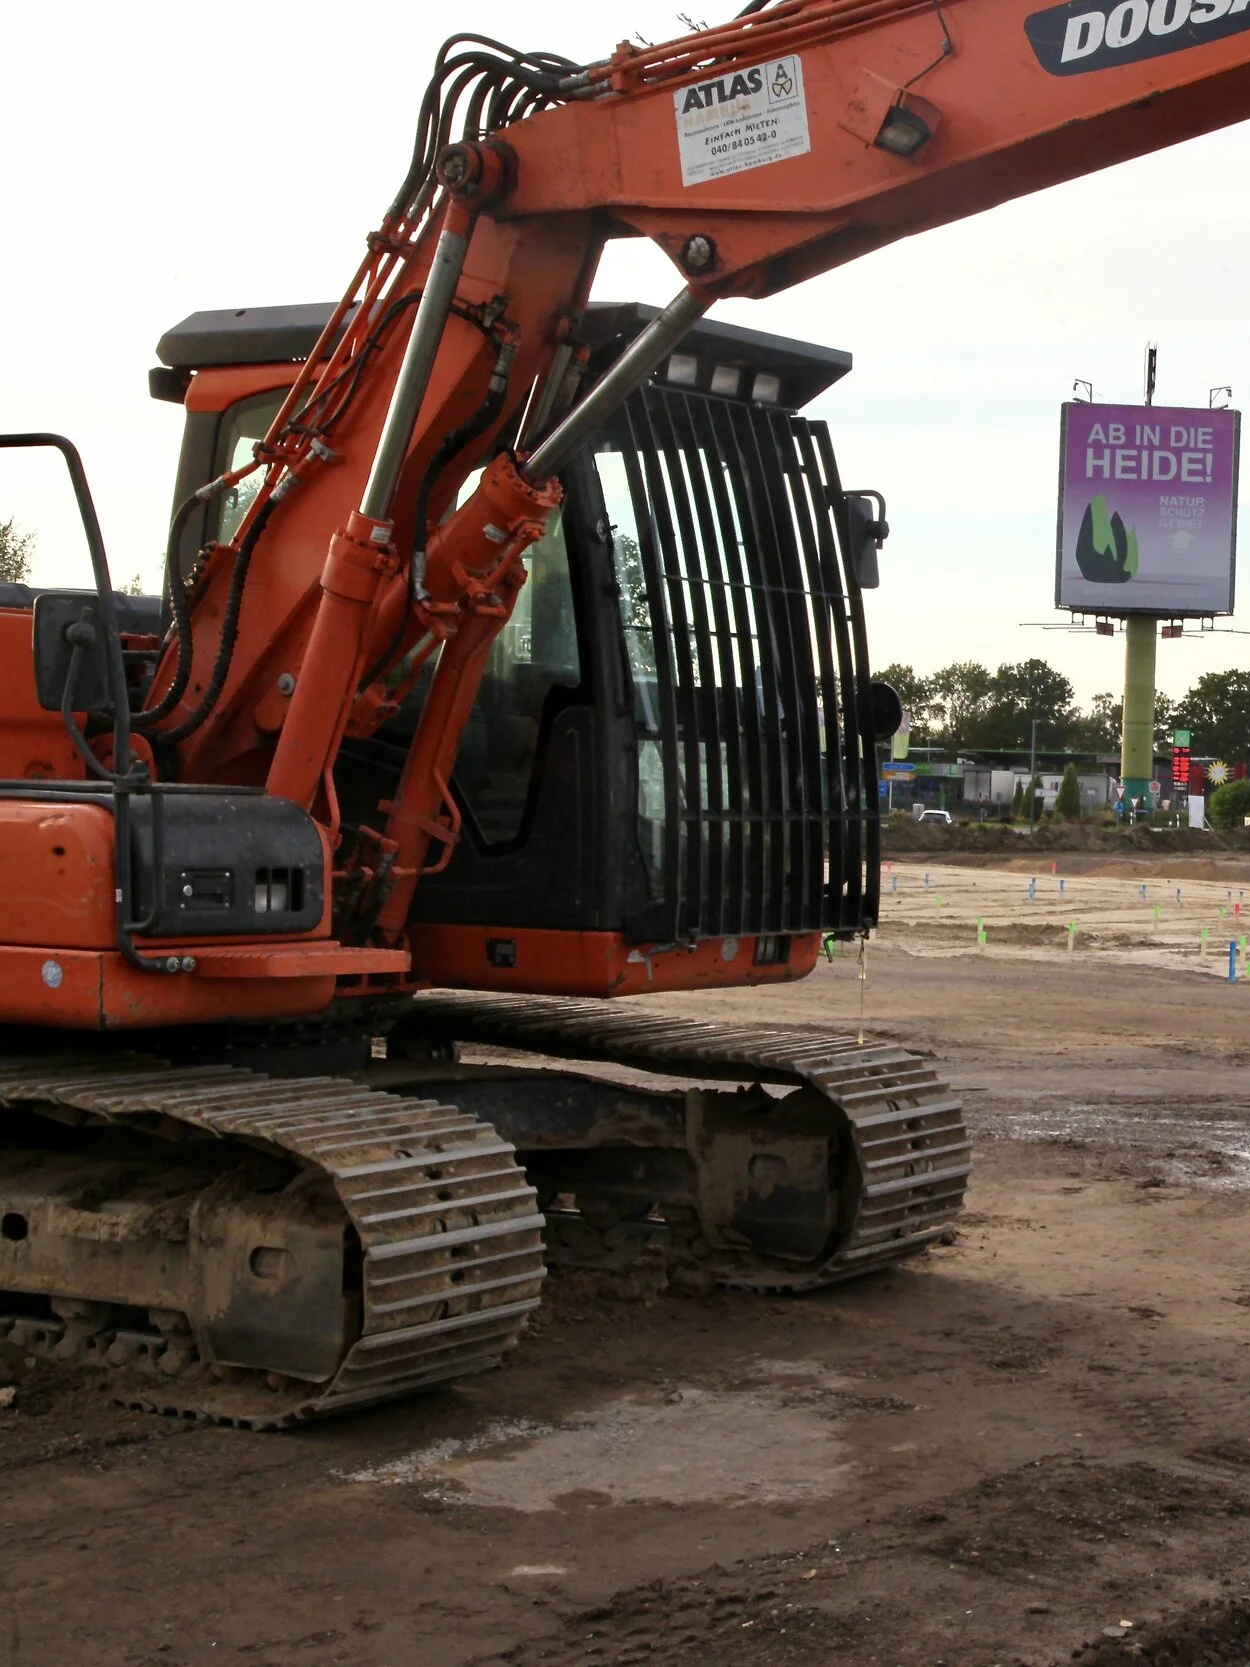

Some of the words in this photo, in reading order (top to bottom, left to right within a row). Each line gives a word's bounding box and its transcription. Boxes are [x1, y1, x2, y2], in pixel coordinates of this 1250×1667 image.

[682, 68, 763, 114] ATLAS
[704, 128, 741, 145] EINFACH
[1087, 423, 1126, 445] AB
[1136, 425, 1160, 447] IN
[1170, 427, 1213, 448] DIE
[1086, 449, 1213, 482] HEIDE!
[1160, 496, 1205, 507] NATUR
[1160, 507, 1205, 518] SCHUTZ
